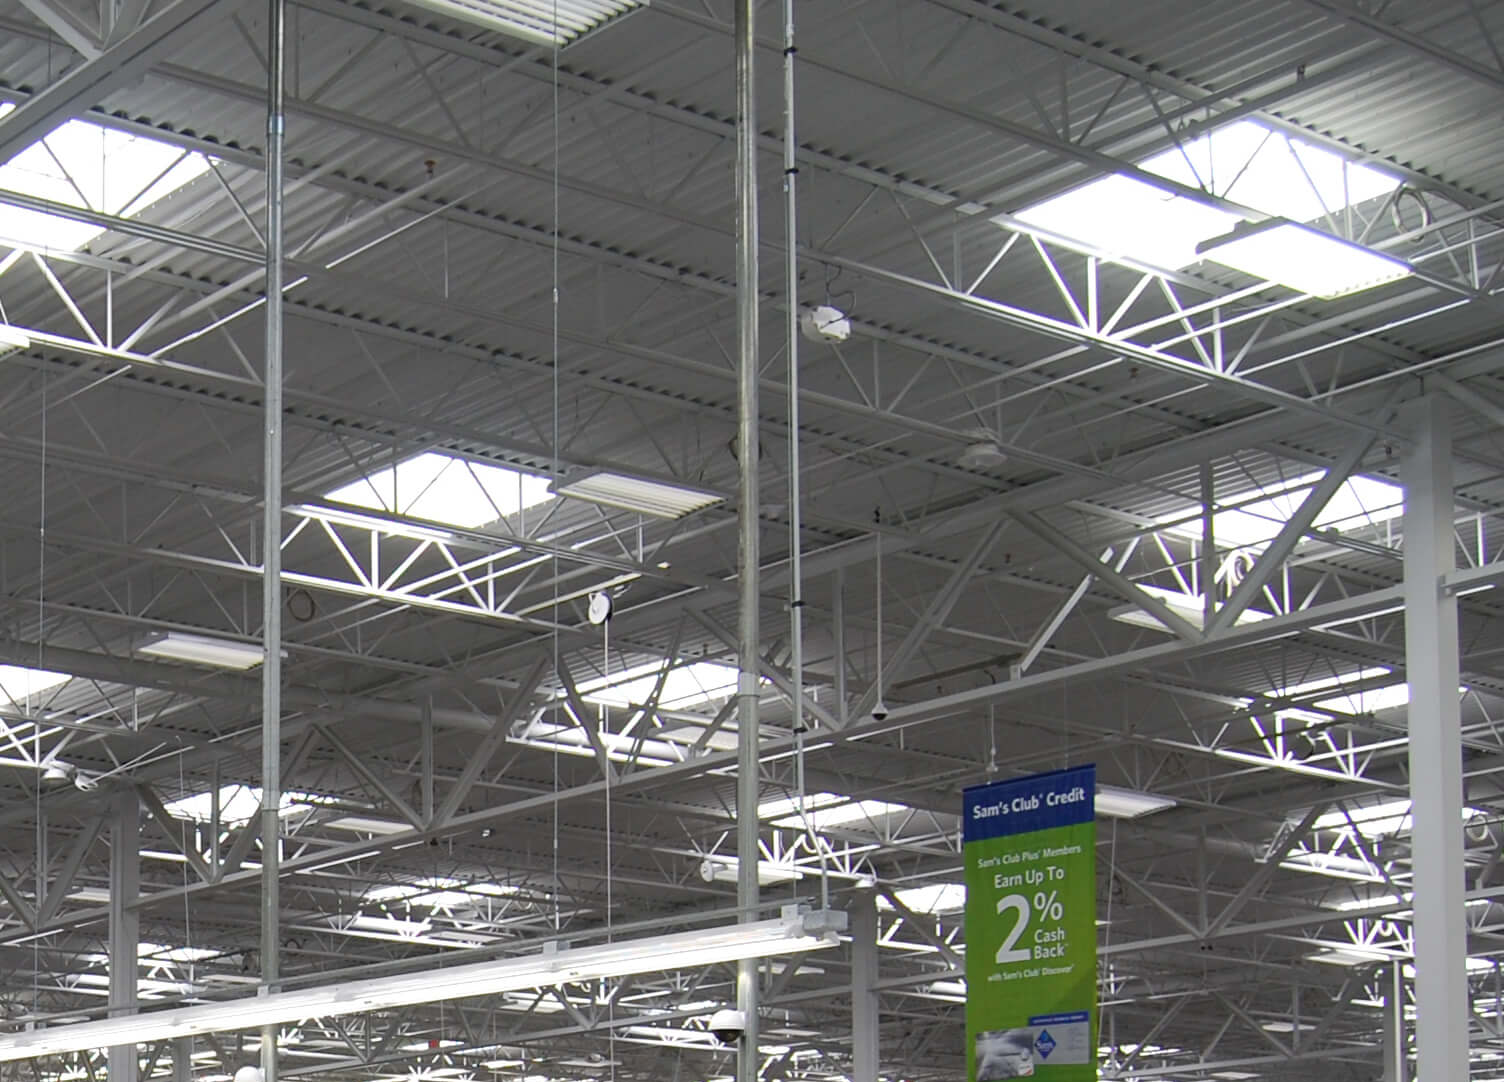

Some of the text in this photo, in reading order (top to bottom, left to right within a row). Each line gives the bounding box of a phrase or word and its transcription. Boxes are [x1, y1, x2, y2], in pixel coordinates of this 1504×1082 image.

[973, 801, 1009, 819] Sam's
[1046, 787, 1085, 806] Credit
[994, 866, 1064, 889] Earn Up To
[1034, 927, 1065, 943] Cash
[1034, 943, 1065, 959] Back
